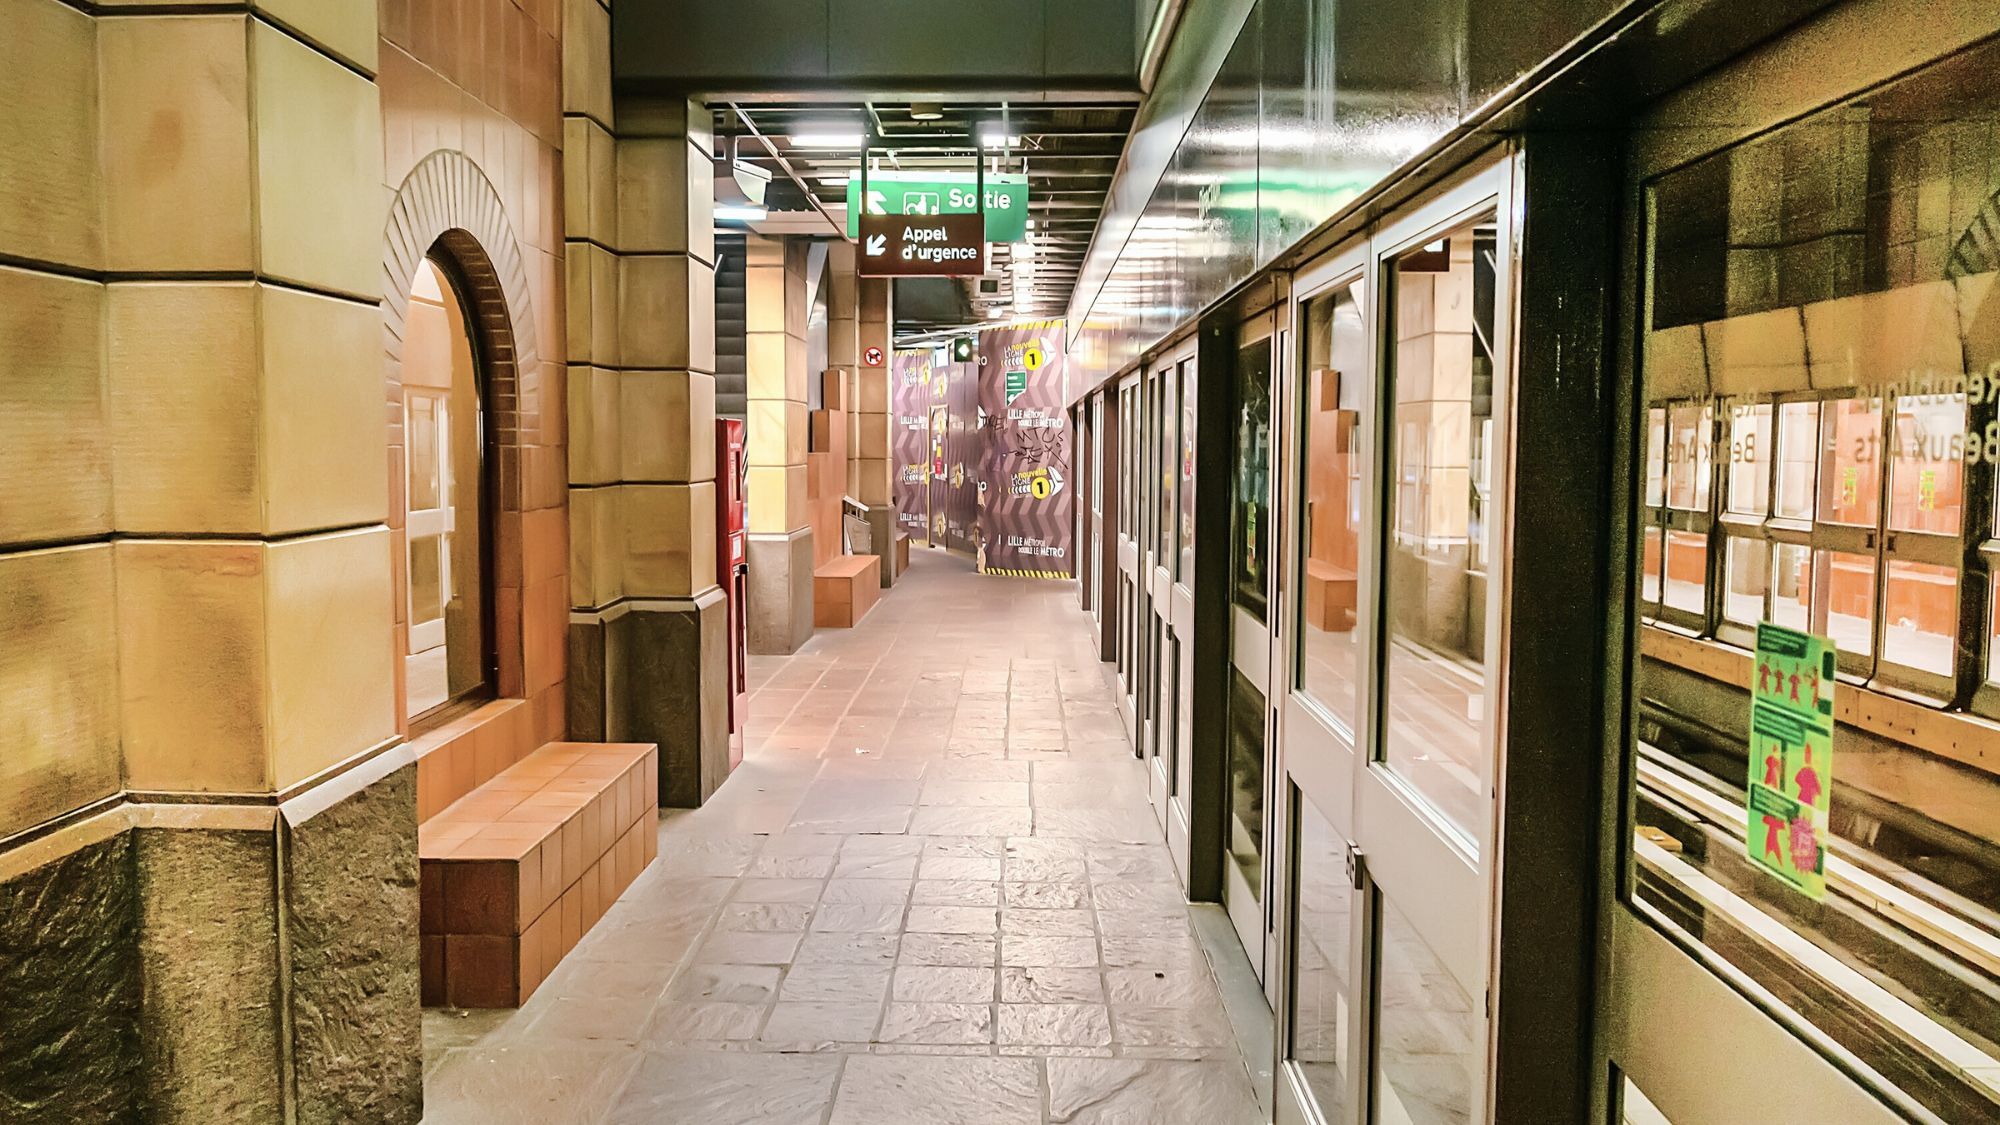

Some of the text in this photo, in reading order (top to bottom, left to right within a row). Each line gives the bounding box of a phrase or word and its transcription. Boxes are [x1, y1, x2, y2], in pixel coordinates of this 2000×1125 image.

[949, 188, 1011, 209] Sotie
[902, 226, 948, 244] Appel
[902, 245, 977, 262] d'urgence
[1029, 353, 1036, 366] 1
[1007, 409, 1023, 419] LILLE
[1018, 467, 1048, 479] nouvelle
[1011, 477, 1043, 494] LIGNE 1
[1007, 535, 1023, 546] LILLE
[1040, 545, 1065, 558] MÉTRO
